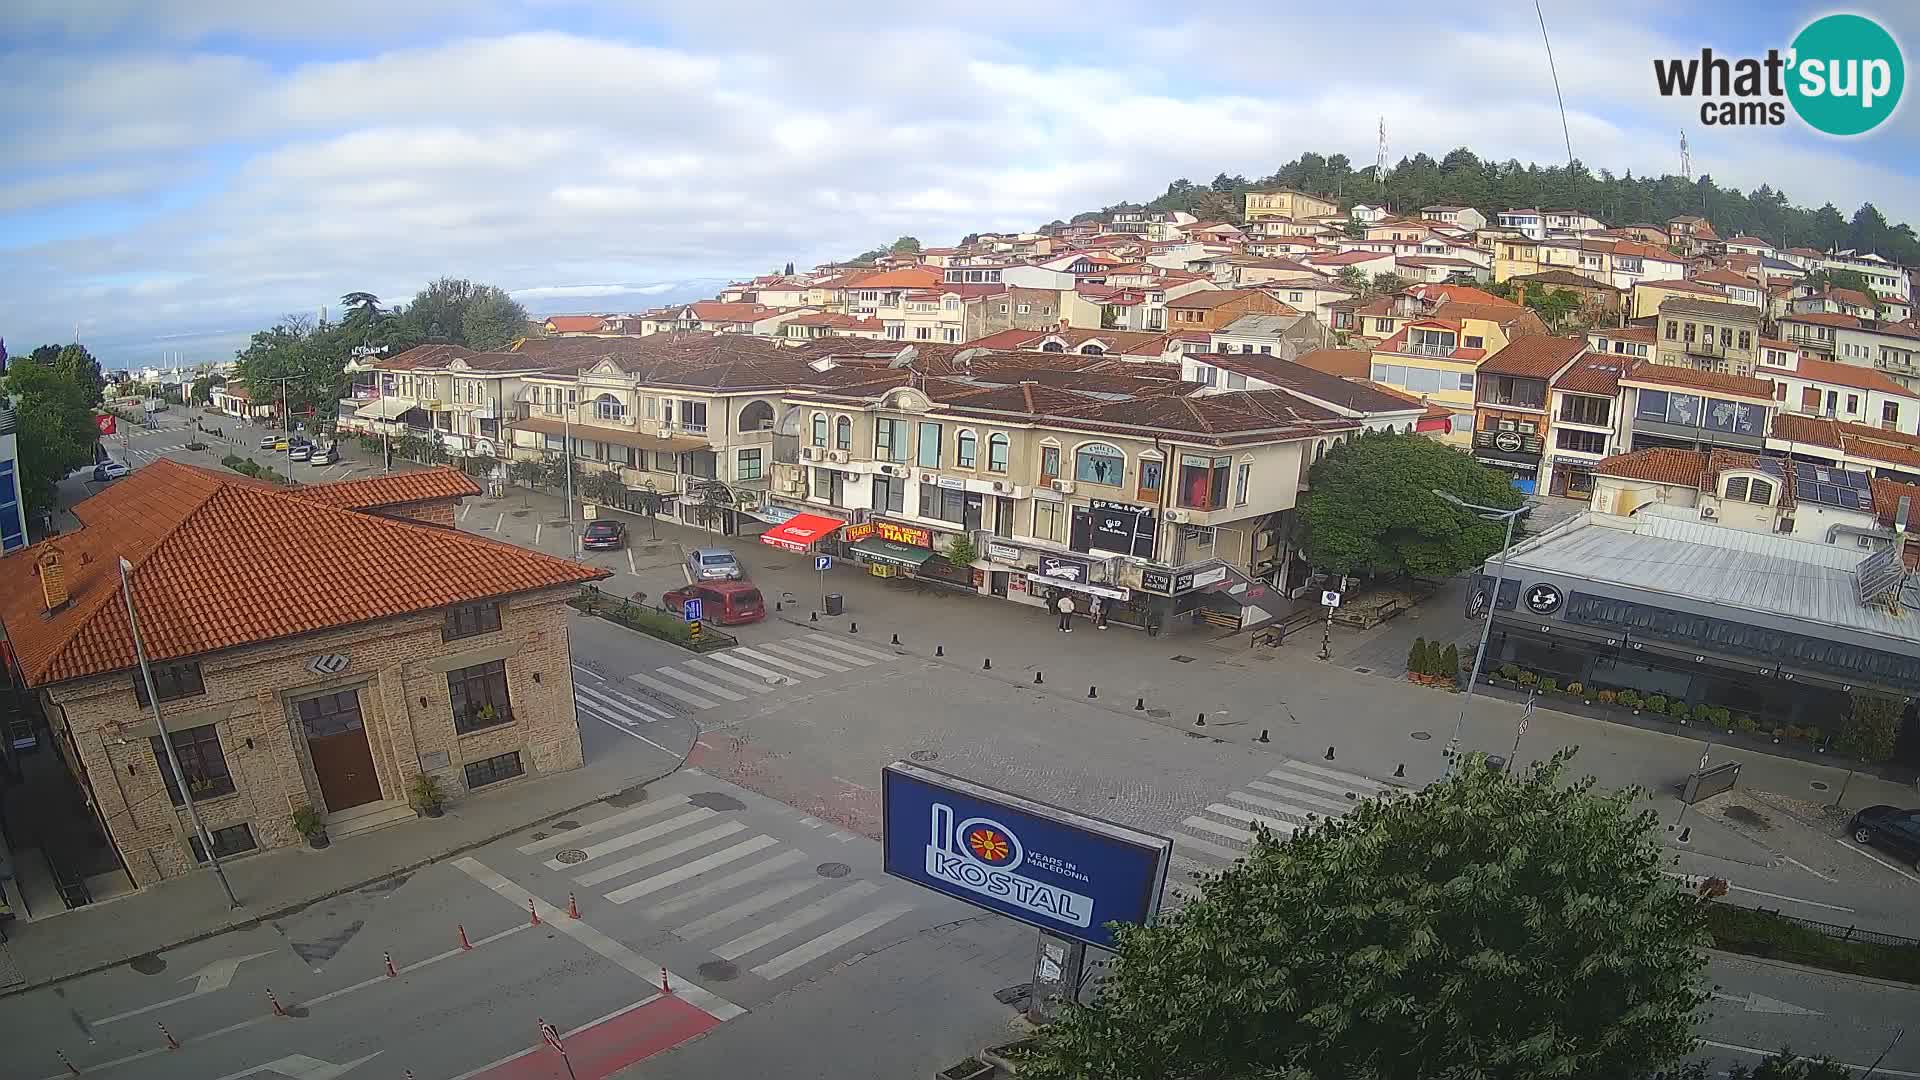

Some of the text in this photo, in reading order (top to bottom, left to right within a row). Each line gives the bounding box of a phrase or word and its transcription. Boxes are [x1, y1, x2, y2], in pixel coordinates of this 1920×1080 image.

[1026, 857, 1089, 883] MACEDONIA
[1027, 850, 1077, 872] YEARS IN
[935, 852, 1081, 921] KOSTAL
